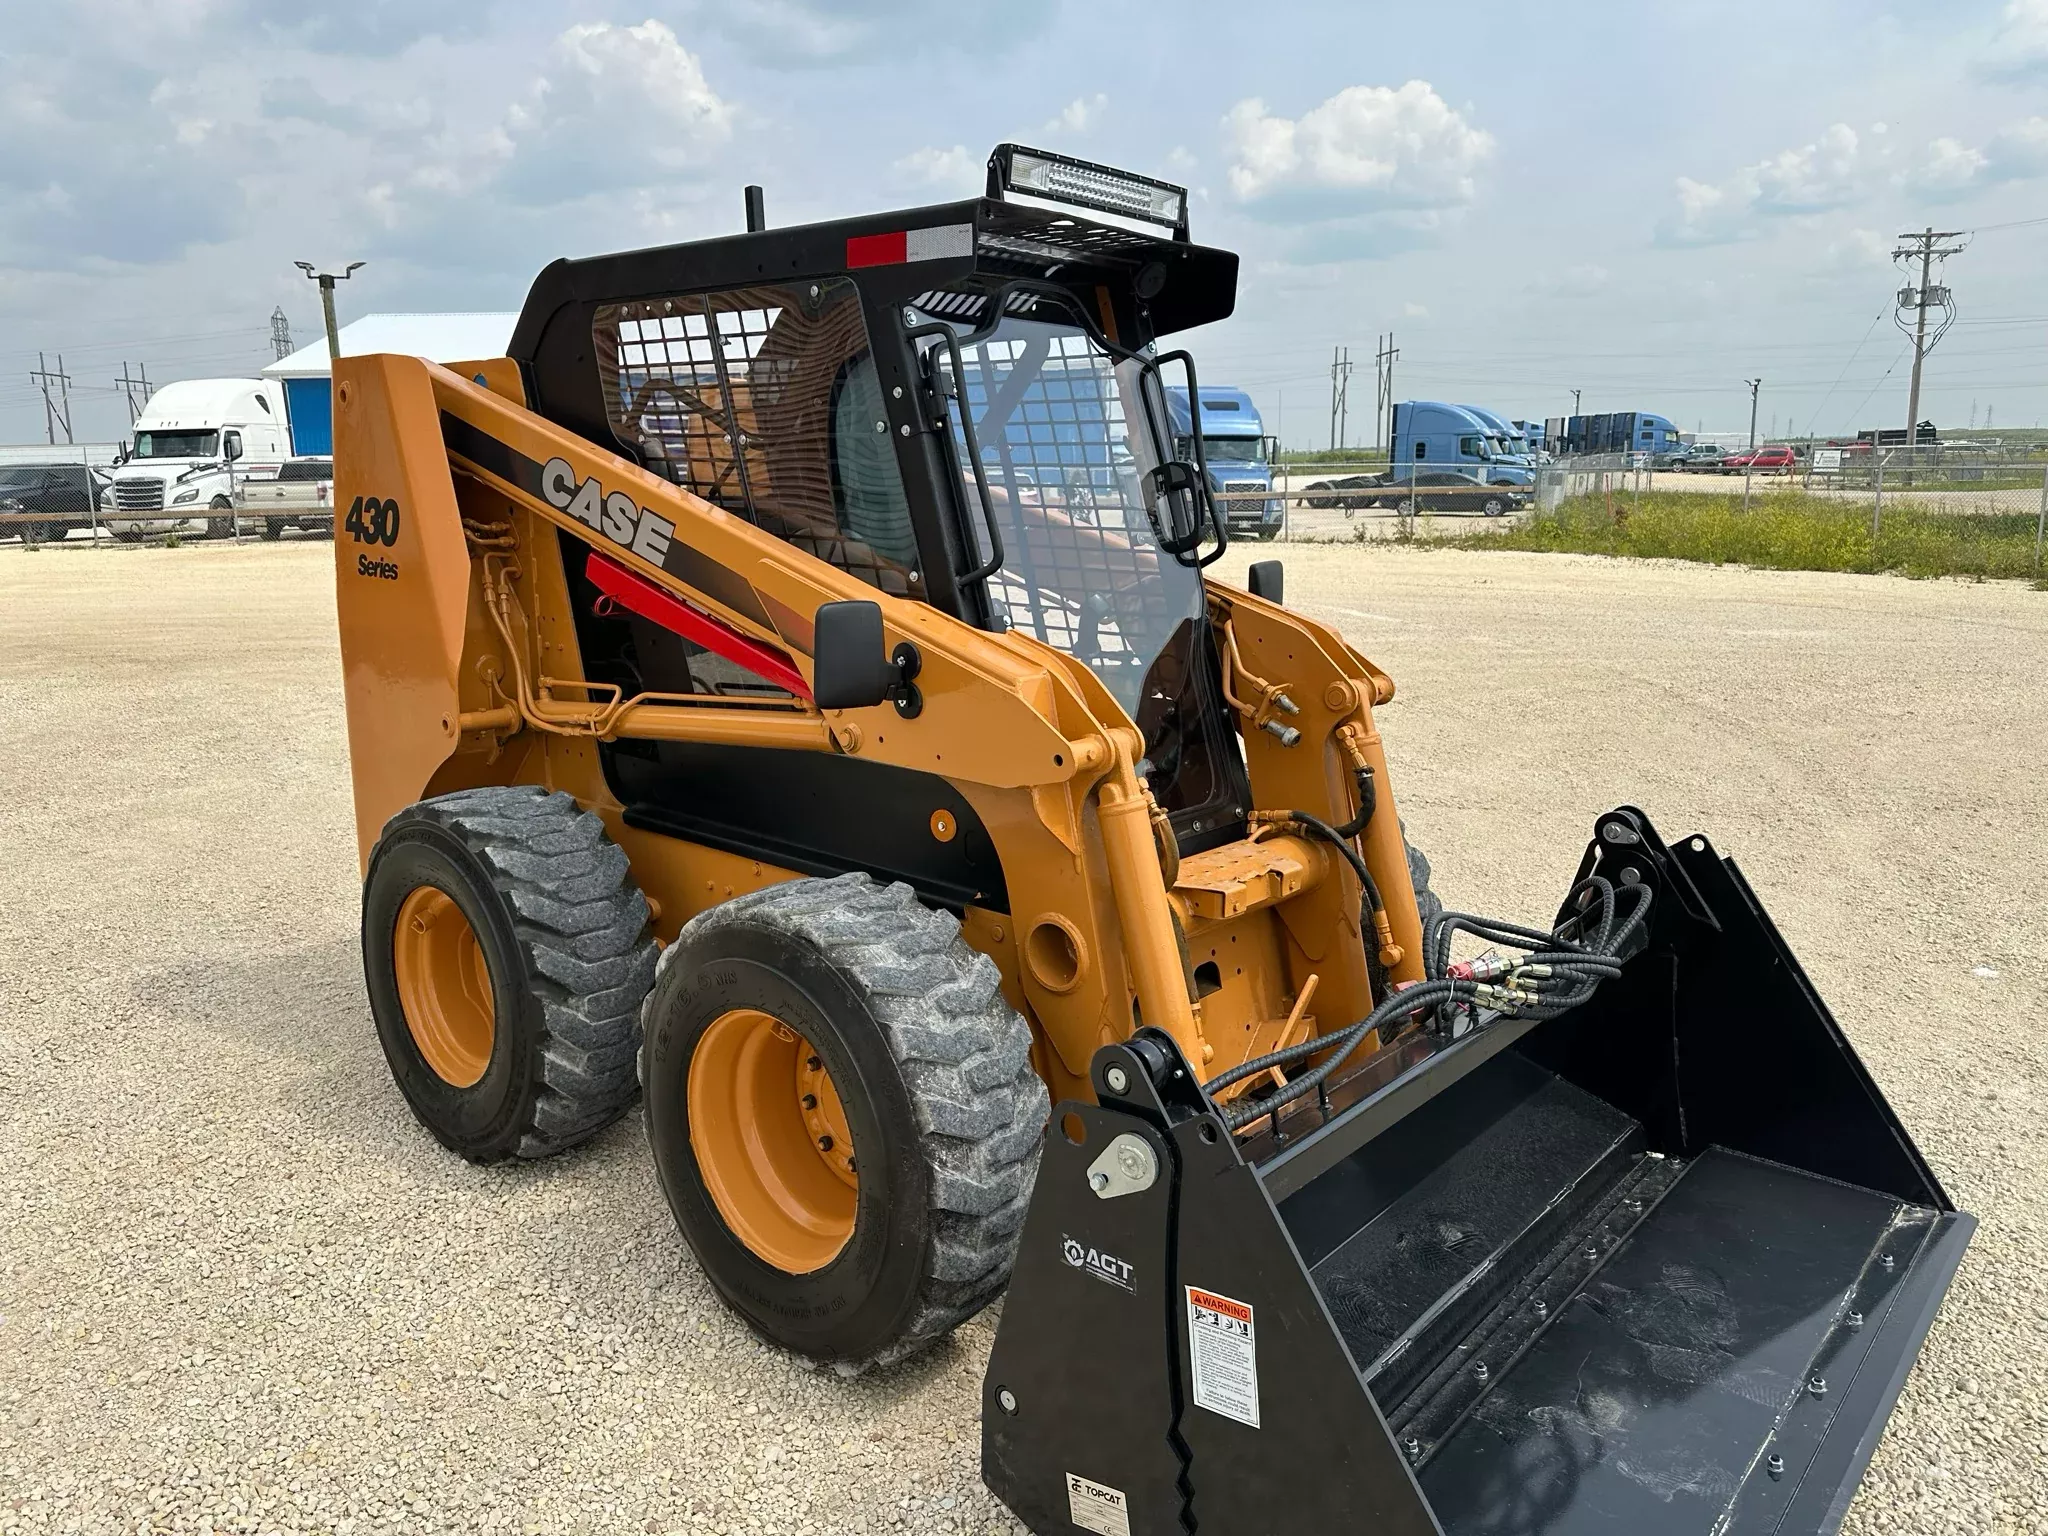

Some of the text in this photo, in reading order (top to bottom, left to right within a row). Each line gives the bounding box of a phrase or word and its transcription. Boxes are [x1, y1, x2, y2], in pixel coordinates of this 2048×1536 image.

[345, 496, 400, 547] 430
[542, 457, 676, 568] CASE
[358, 554, 398, 580] Series
[1086, 1248, 1134, 1280] AGT
[1202, 1297, 1248, 1319] WARNING
[1085, 1485, 1121, 1505] TOPCAT
